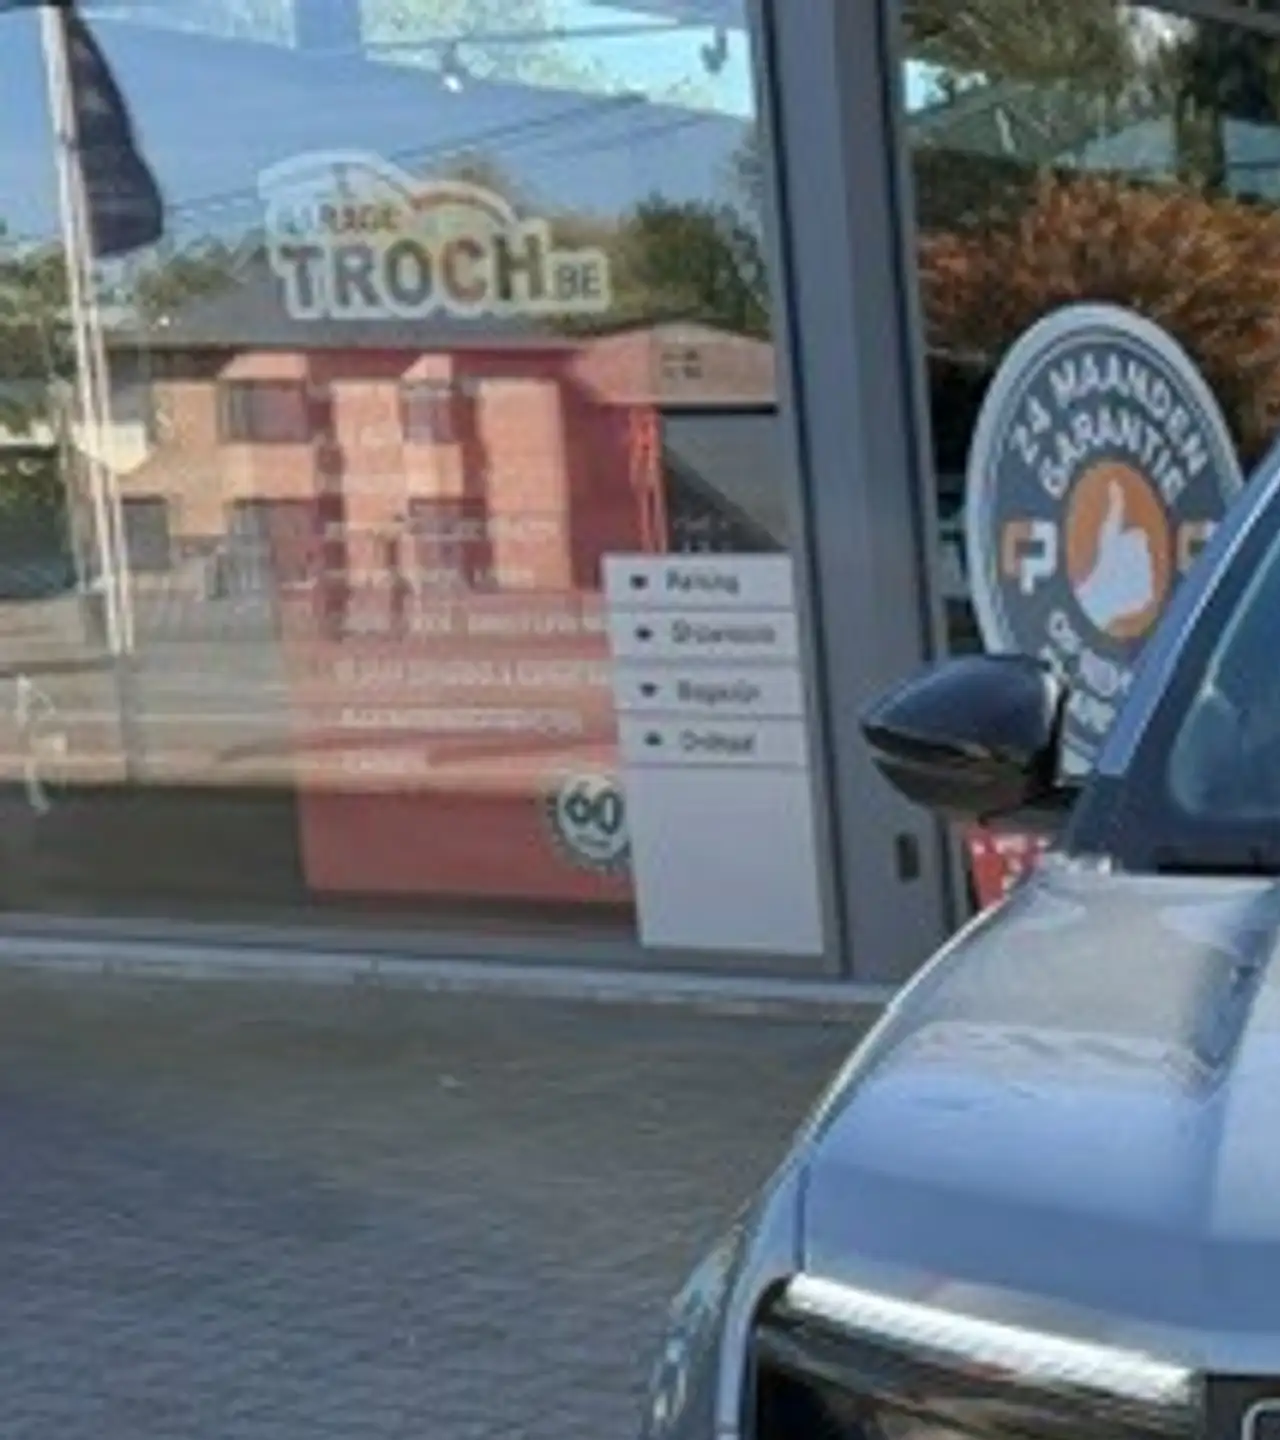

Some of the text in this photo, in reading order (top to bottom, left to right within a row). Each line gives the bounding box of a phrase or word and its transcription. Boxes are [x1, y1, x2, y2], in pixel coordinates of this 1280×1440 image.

[266, 204, 402, 234] RAGE
[279, 231, 547, 309] TROCH
[1049, 352, 1208, 478] MAANDEN
[1036, 405, 1188, 504] GARANTIE
[564, 780, 624, 836] 60
